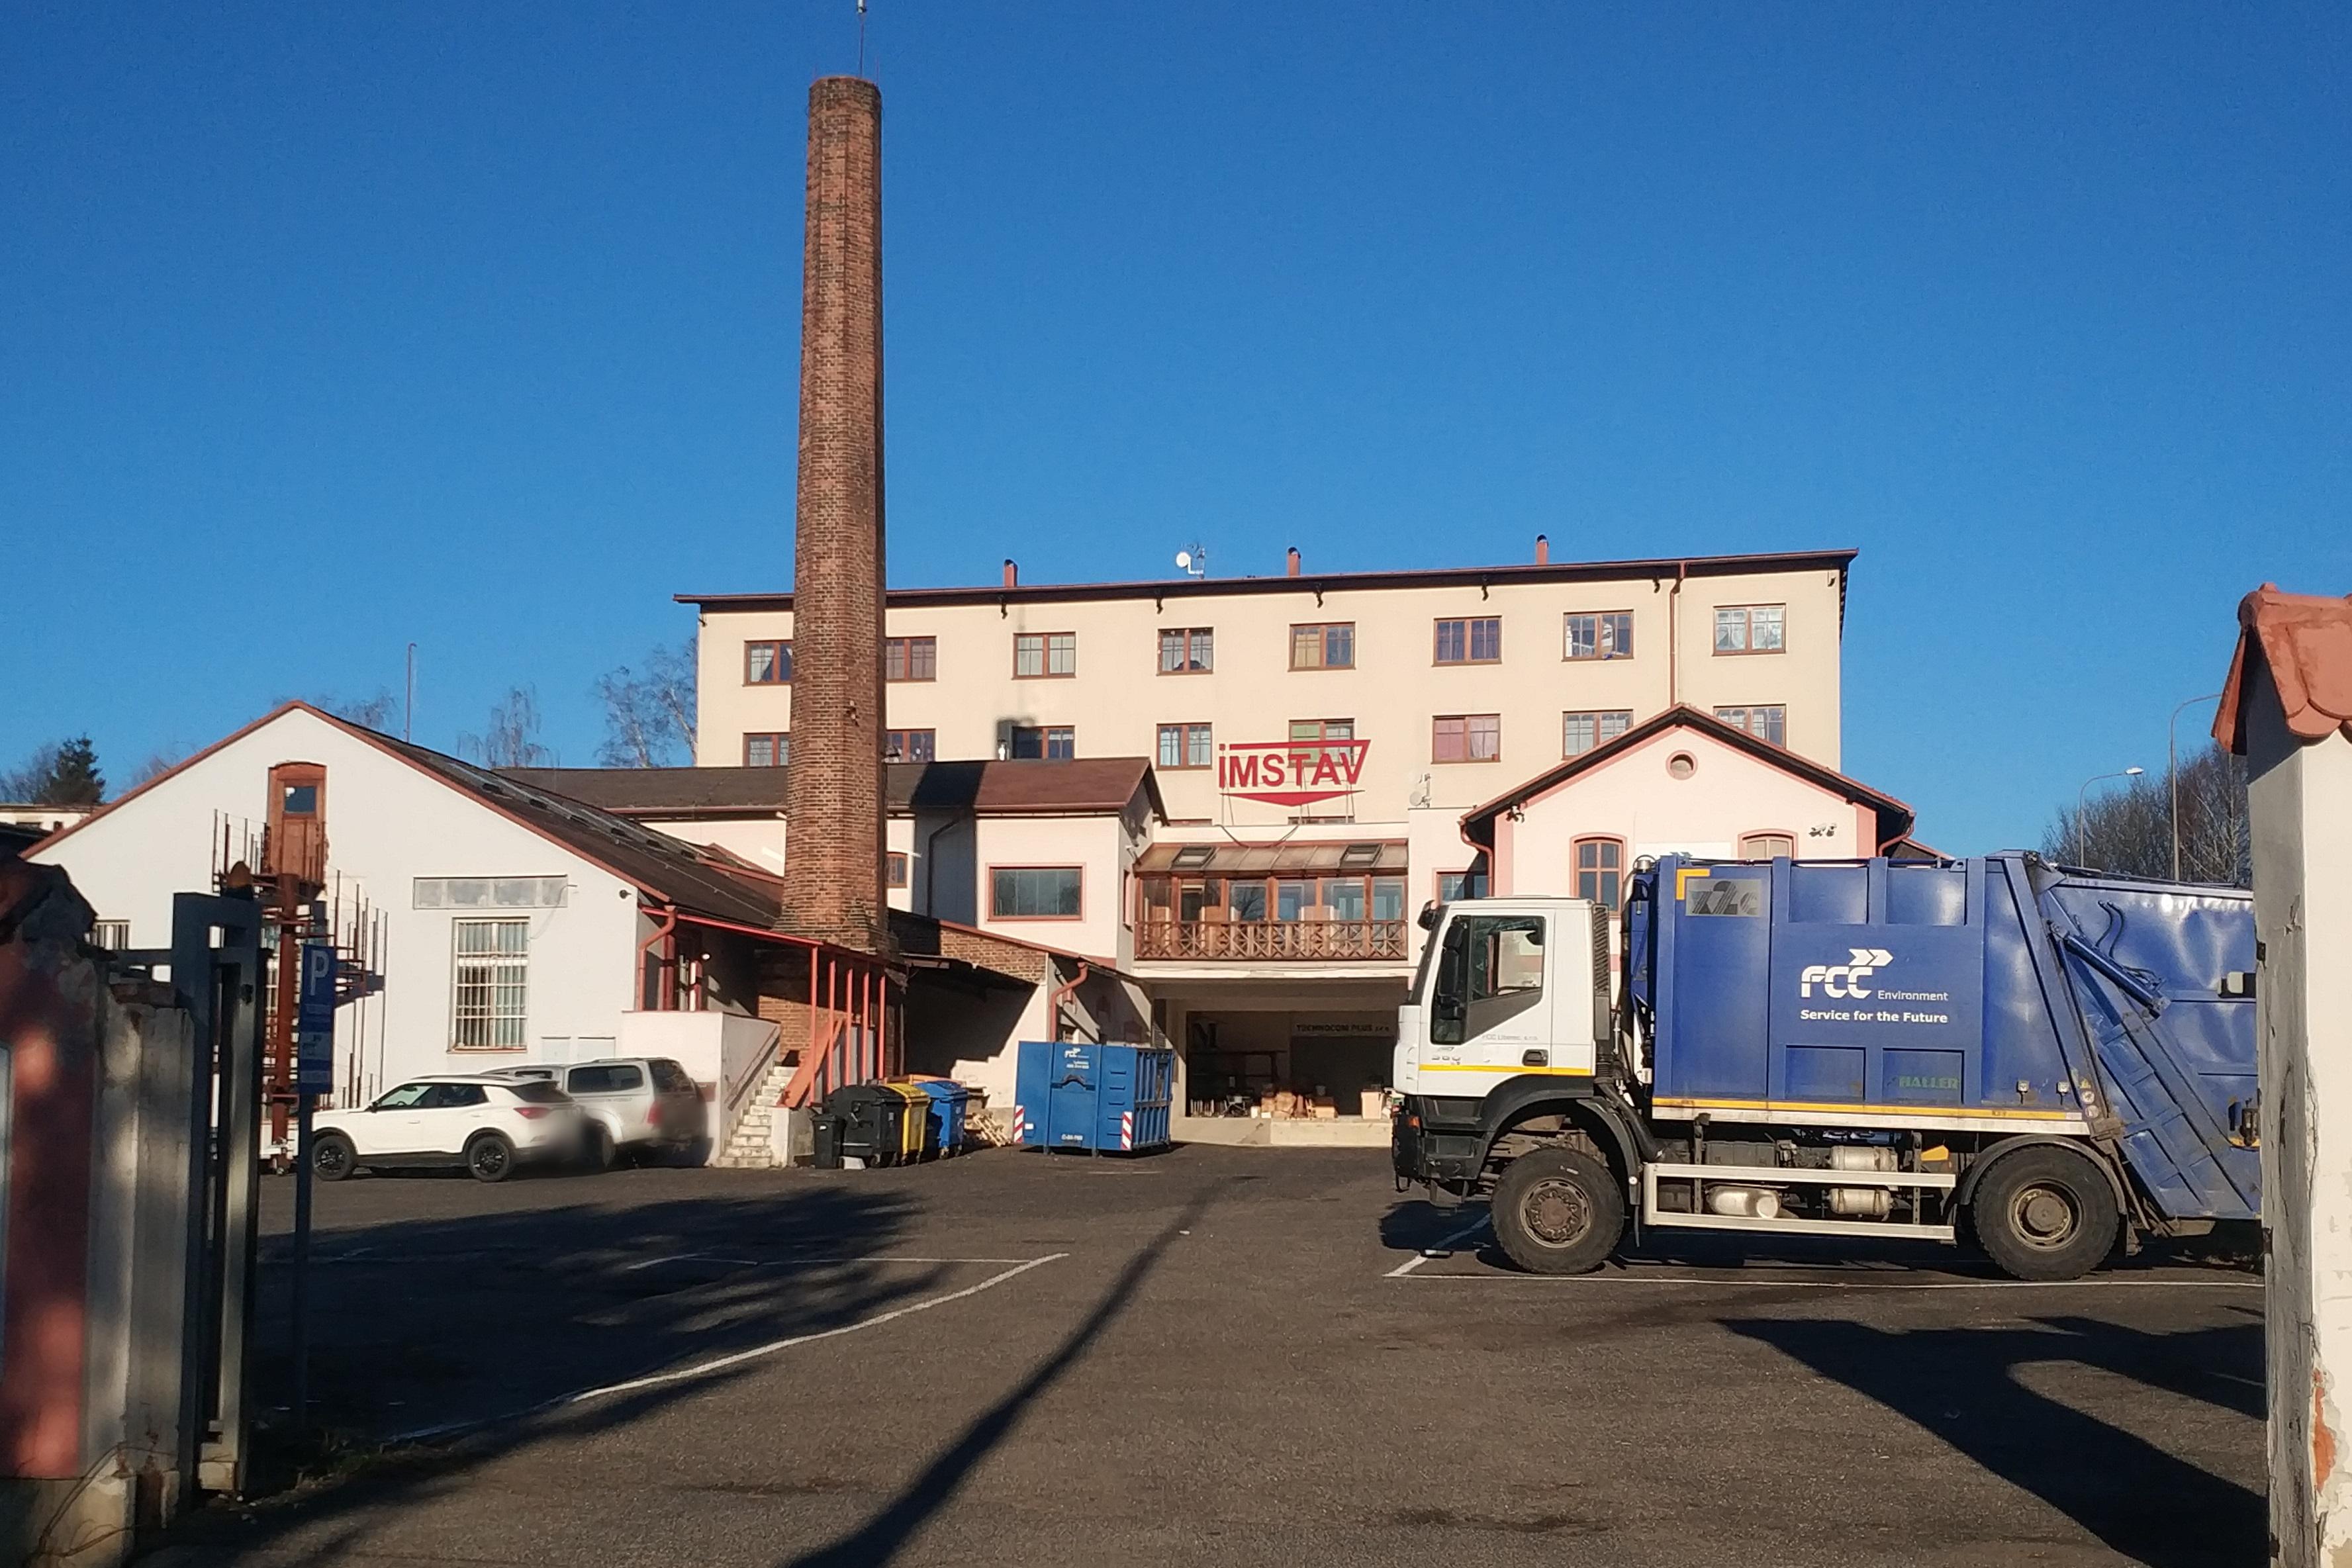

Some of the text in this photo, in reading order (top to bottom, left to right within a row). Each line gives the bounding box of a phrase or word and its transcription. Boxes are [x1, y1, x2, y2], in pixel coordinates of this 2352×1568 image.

[310, 949, 329, 996] P
[1801, 965, 1949, 1001] FCC Environment
[1800, 1009, 1948, 1023] Service for the Future
[1899, 1076, 1959, 1090] HALLER
